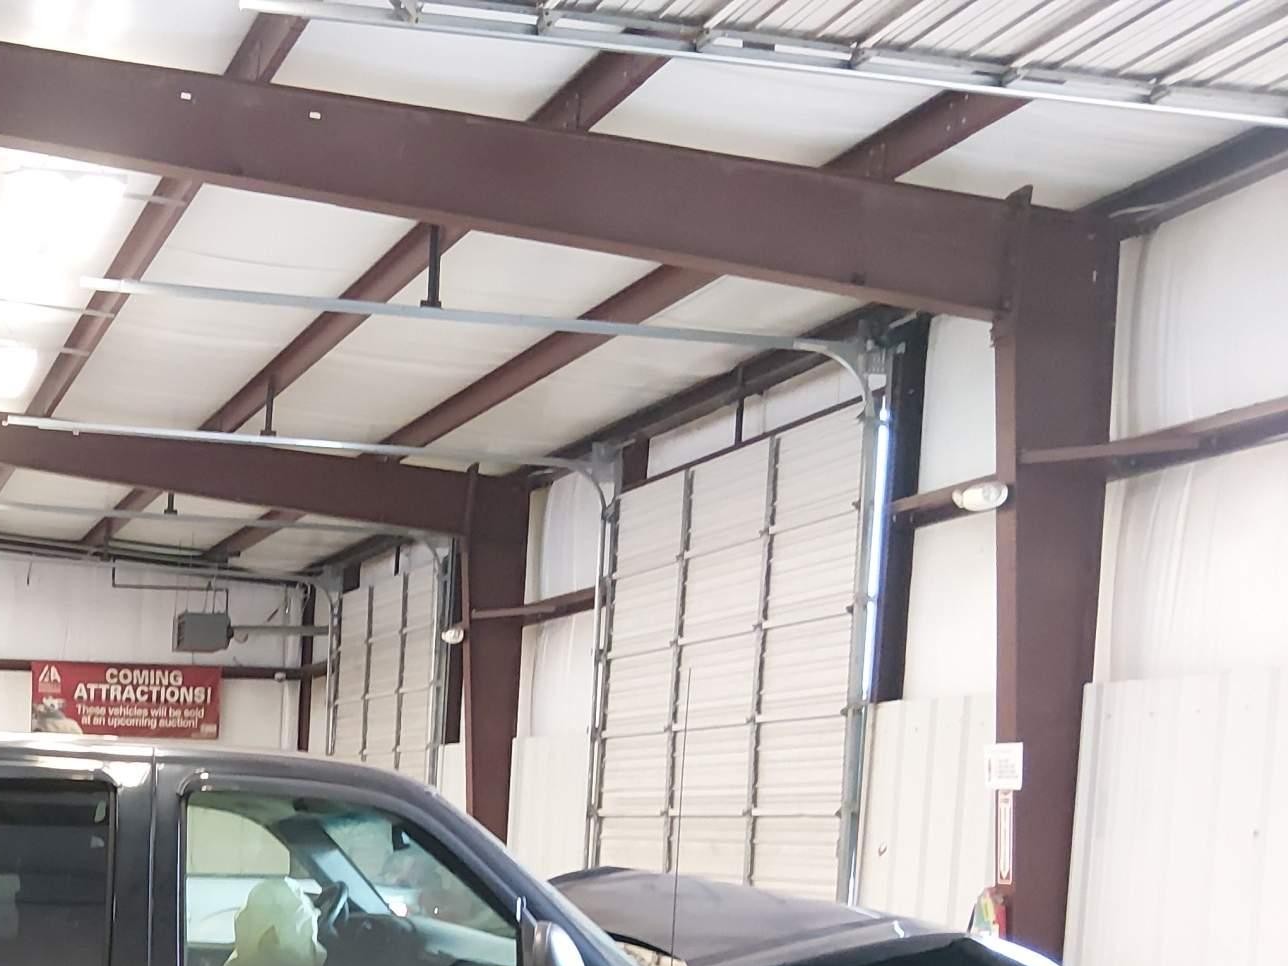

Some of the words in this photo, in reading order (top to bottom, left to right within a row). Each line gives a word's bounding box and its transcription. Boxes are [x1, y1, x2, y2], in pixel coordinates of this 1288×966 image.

[105, 668, 183, 686] COMING
[74, 683, 211, 704] ATTRACTIONS!
[76, 704, 106, 716] These
[108, 705, 149, 718] vehicles
[151, 706, 167, 717] will
[169, 707, 181, 719] be
[183, 706, 205, 719] sold
[81, 715, 91, 725] at
[93, 716, 106, 726] an
[108, 716, 157, 729] upcoming
[159, 716, 198, 729] auction!
